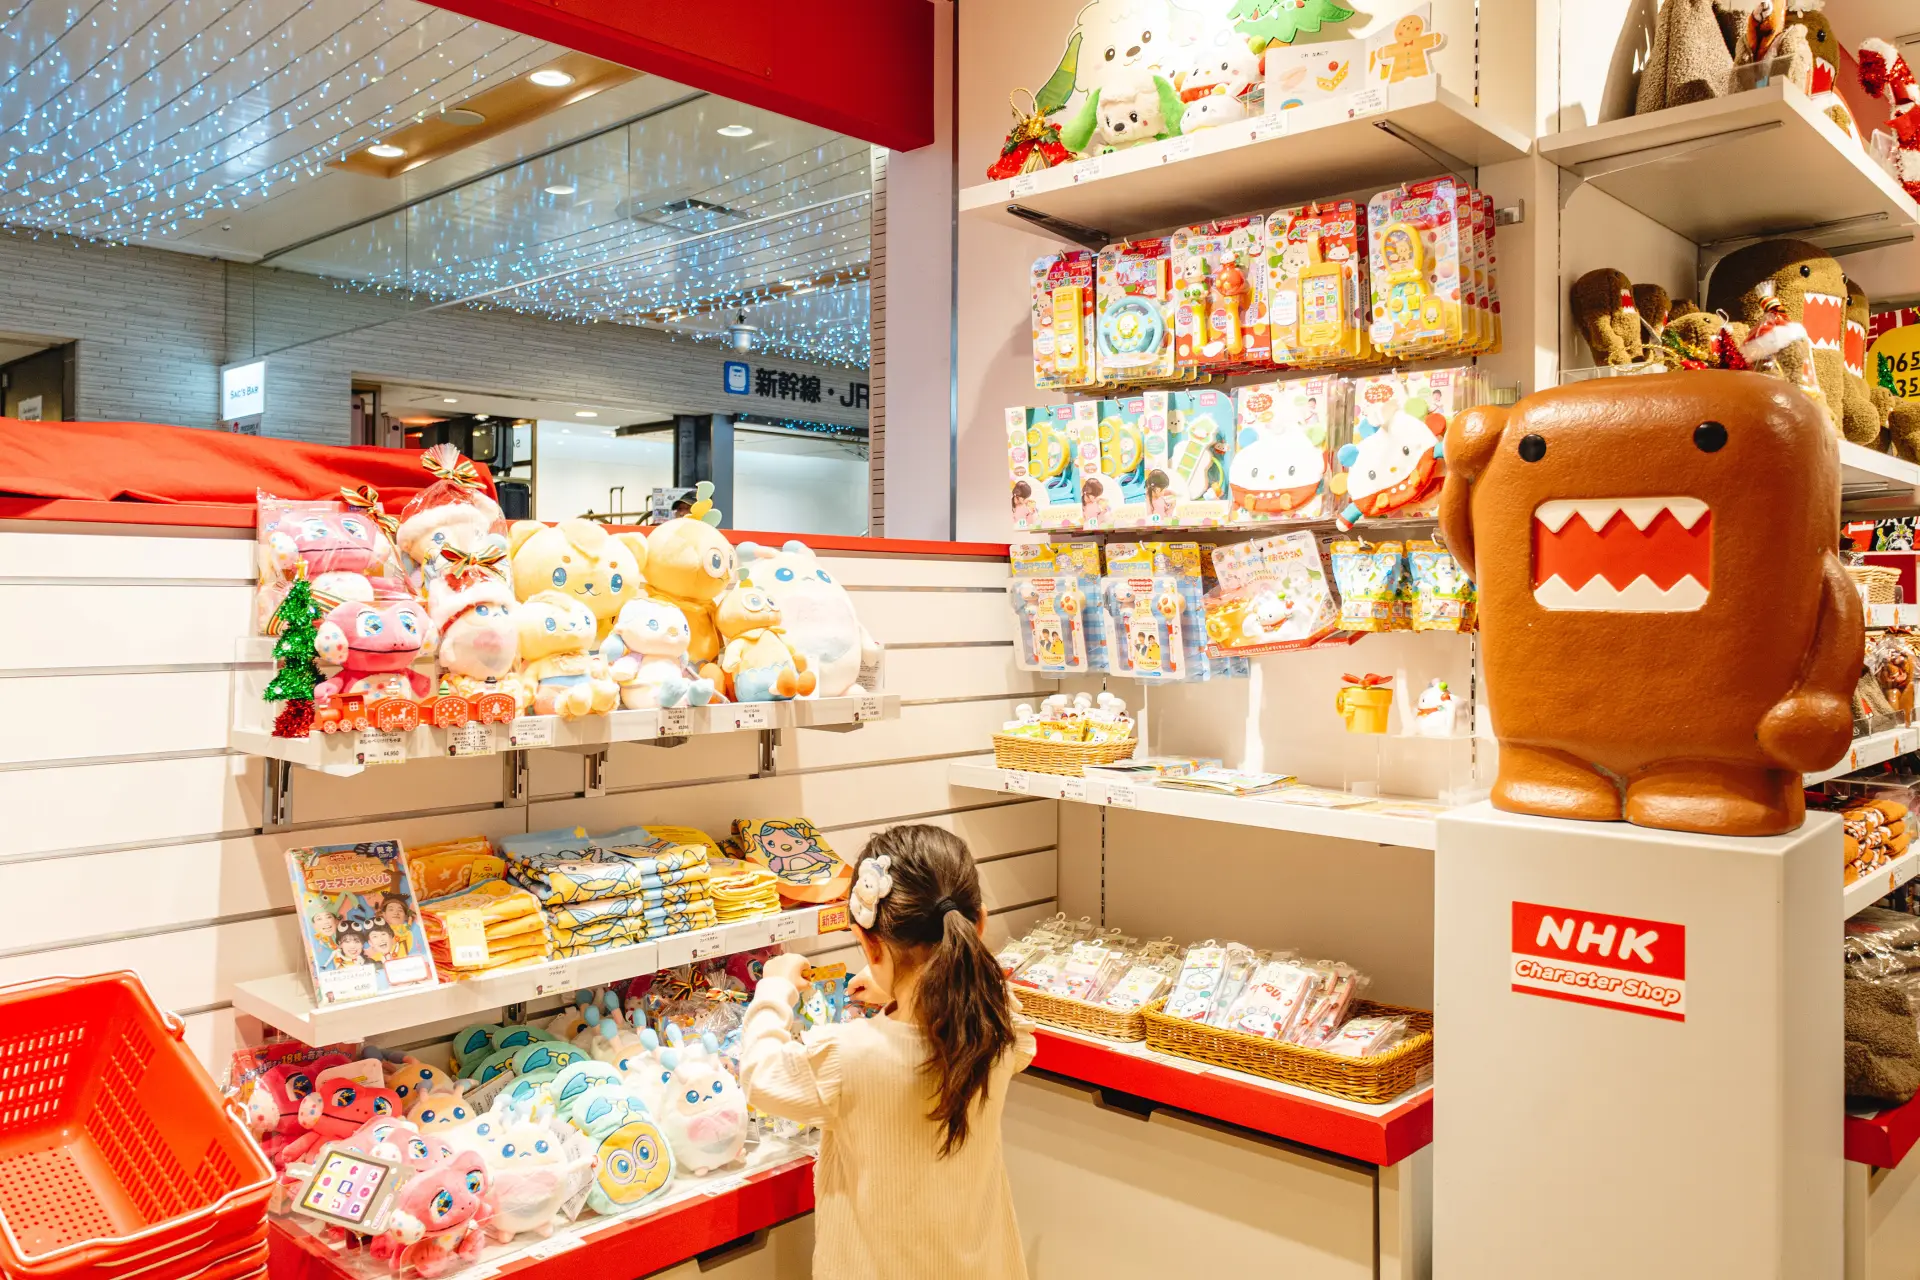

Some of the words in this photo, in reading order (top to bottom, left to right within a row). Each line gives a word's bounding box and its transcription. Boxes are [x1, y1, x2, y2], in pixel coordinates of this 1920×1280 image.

[247, 386, 259, 396] BAR
[315, 873, 391, 889] フェスティバル
[821, 914, 846, 928] 新発売
[1536, 915, 1659, 964] NHK
[1515, 959, 1622, 992] Character
[1622, 979, 1681, 1007] Shop
